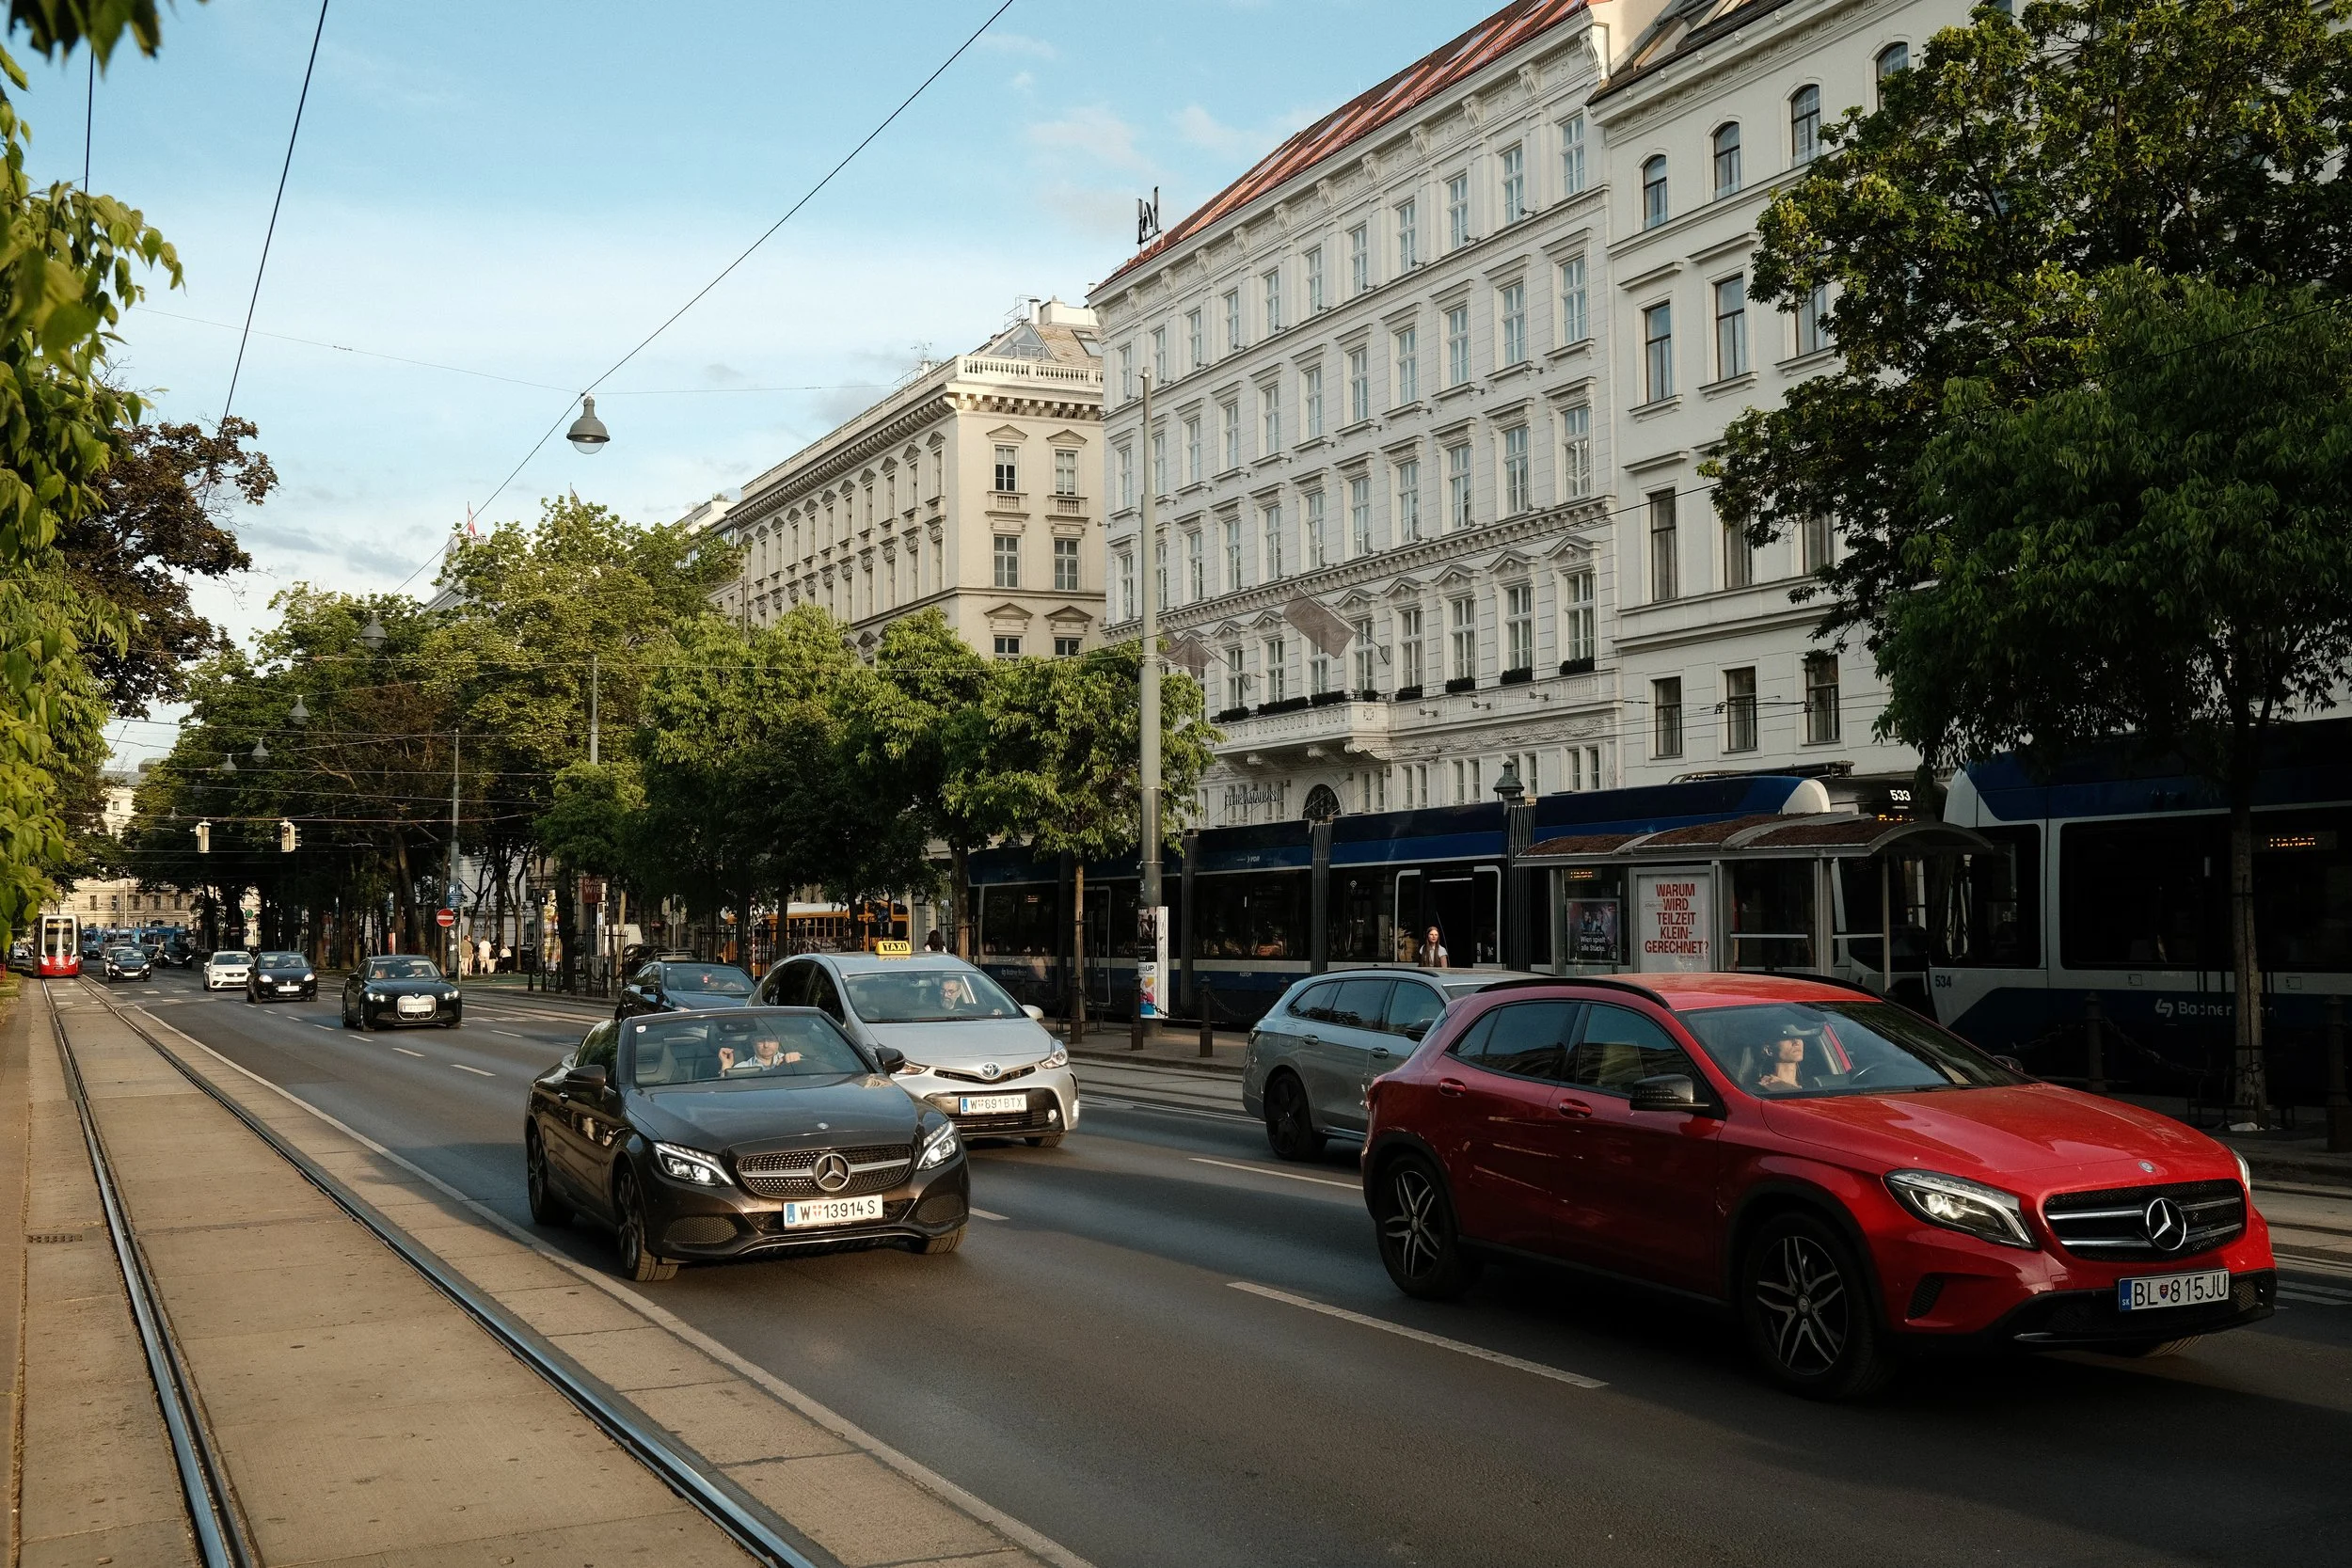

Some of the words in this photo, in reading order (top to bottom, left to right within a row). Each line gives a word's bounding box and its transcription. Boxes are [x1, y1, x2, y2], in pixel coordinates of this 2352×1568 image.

[1889, 789, 1912, 801] 533
[584, 885, 601, 894] WIE
[1656, 883, 1695, 897] WARUM
[1662, 897, 1689, 911] WIRD
[1656, 911, 1696, 926] TEILZEIT
[1660, 926, 1693, 940] KLEIN-
[883, 942, 906, 951] TAXI
[1645, 940, 1709, 954] GERECHNET?
[1935, 974, 1951, 988] 534
[800, 1205, 811, 1221] W
[823, 1201, 864, 1219] 13914
[2122, 1298, 2130, 1307] SK
[2134, 1281, 2158, 1307] BL
[2170, 1274, 2227, 1304] 815JU
